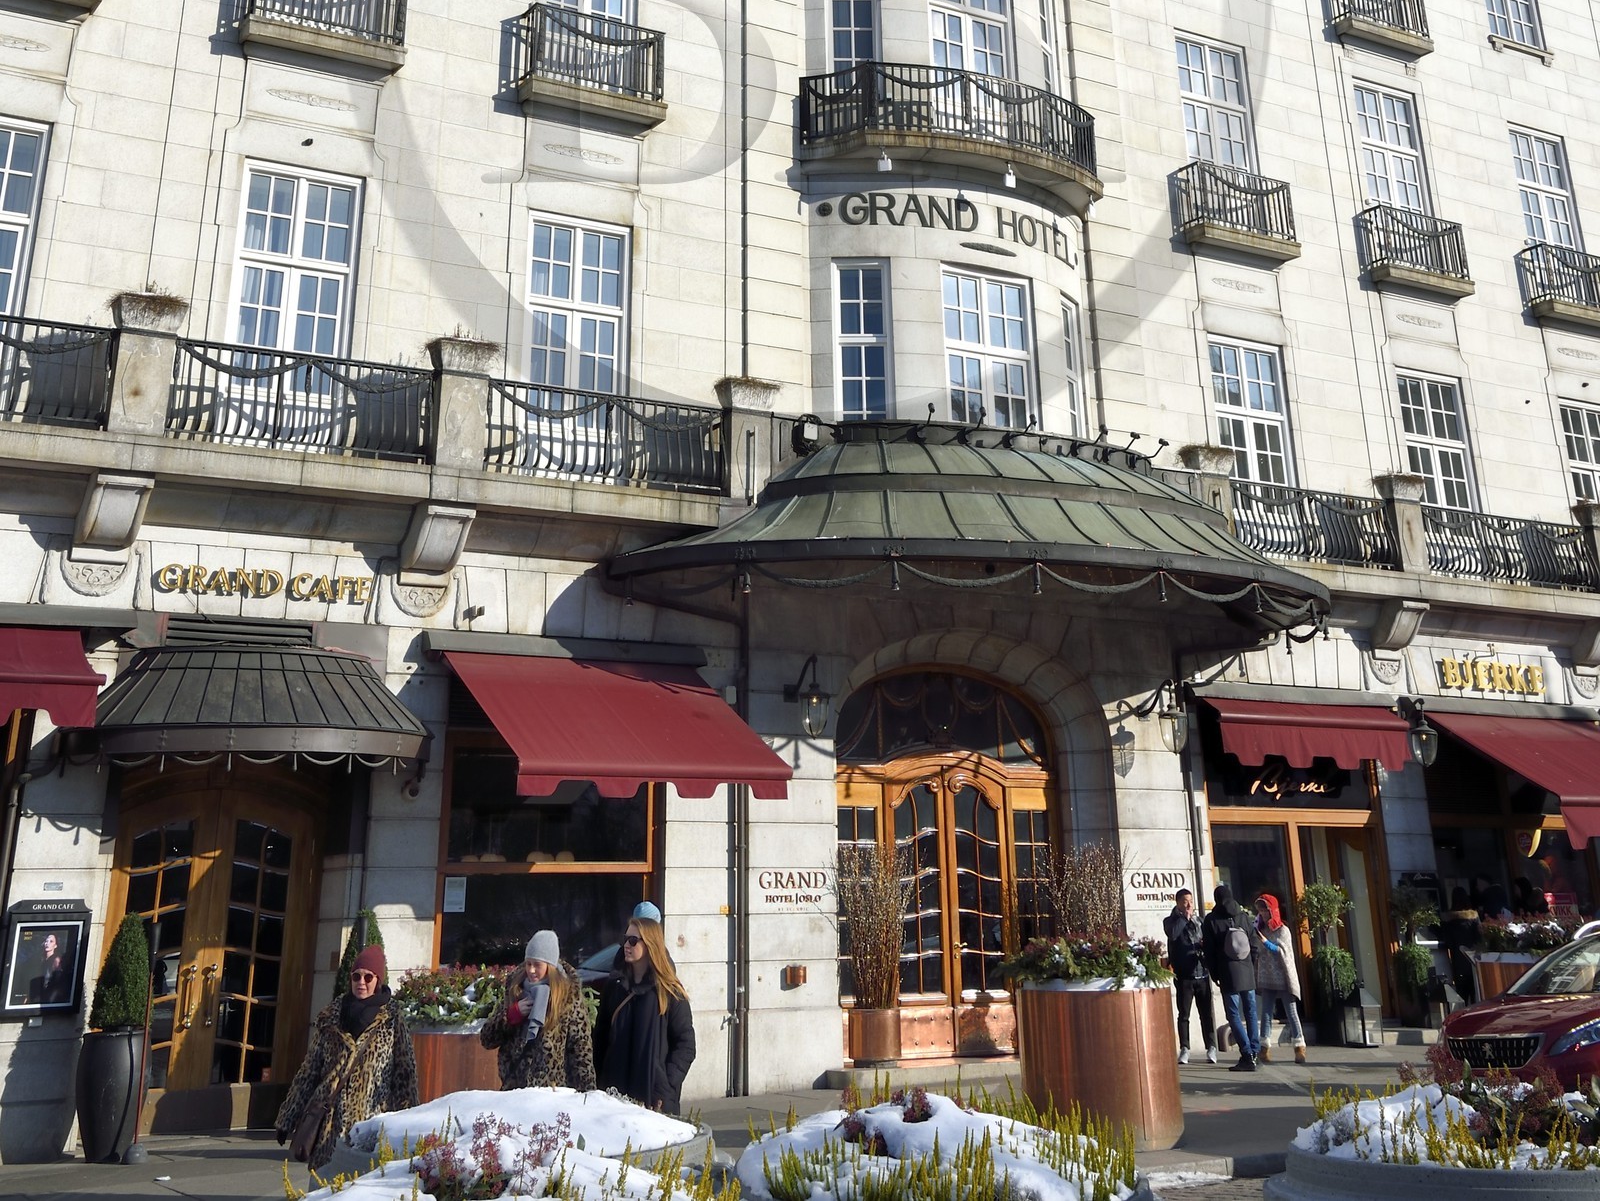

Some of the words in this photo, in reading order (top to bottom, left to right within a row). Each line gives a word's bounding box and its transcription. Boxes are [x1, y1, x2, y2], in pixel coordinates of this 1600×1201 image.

[840, 192, 980, 233] GRAND
[996, 206, 1076, 271] HOTEL
[159, 563, 284, 597] GRAND
[293, 572, 374, 602] CAFE
[1441, 657, 1547, 694] BJERKE
[758, 871, 827, 890] GRAND
[1130, 872, 1186, 889] GRAND
[32, 903, 58, 911] GRAND
[1163, 893, 1177, 902] OSL
